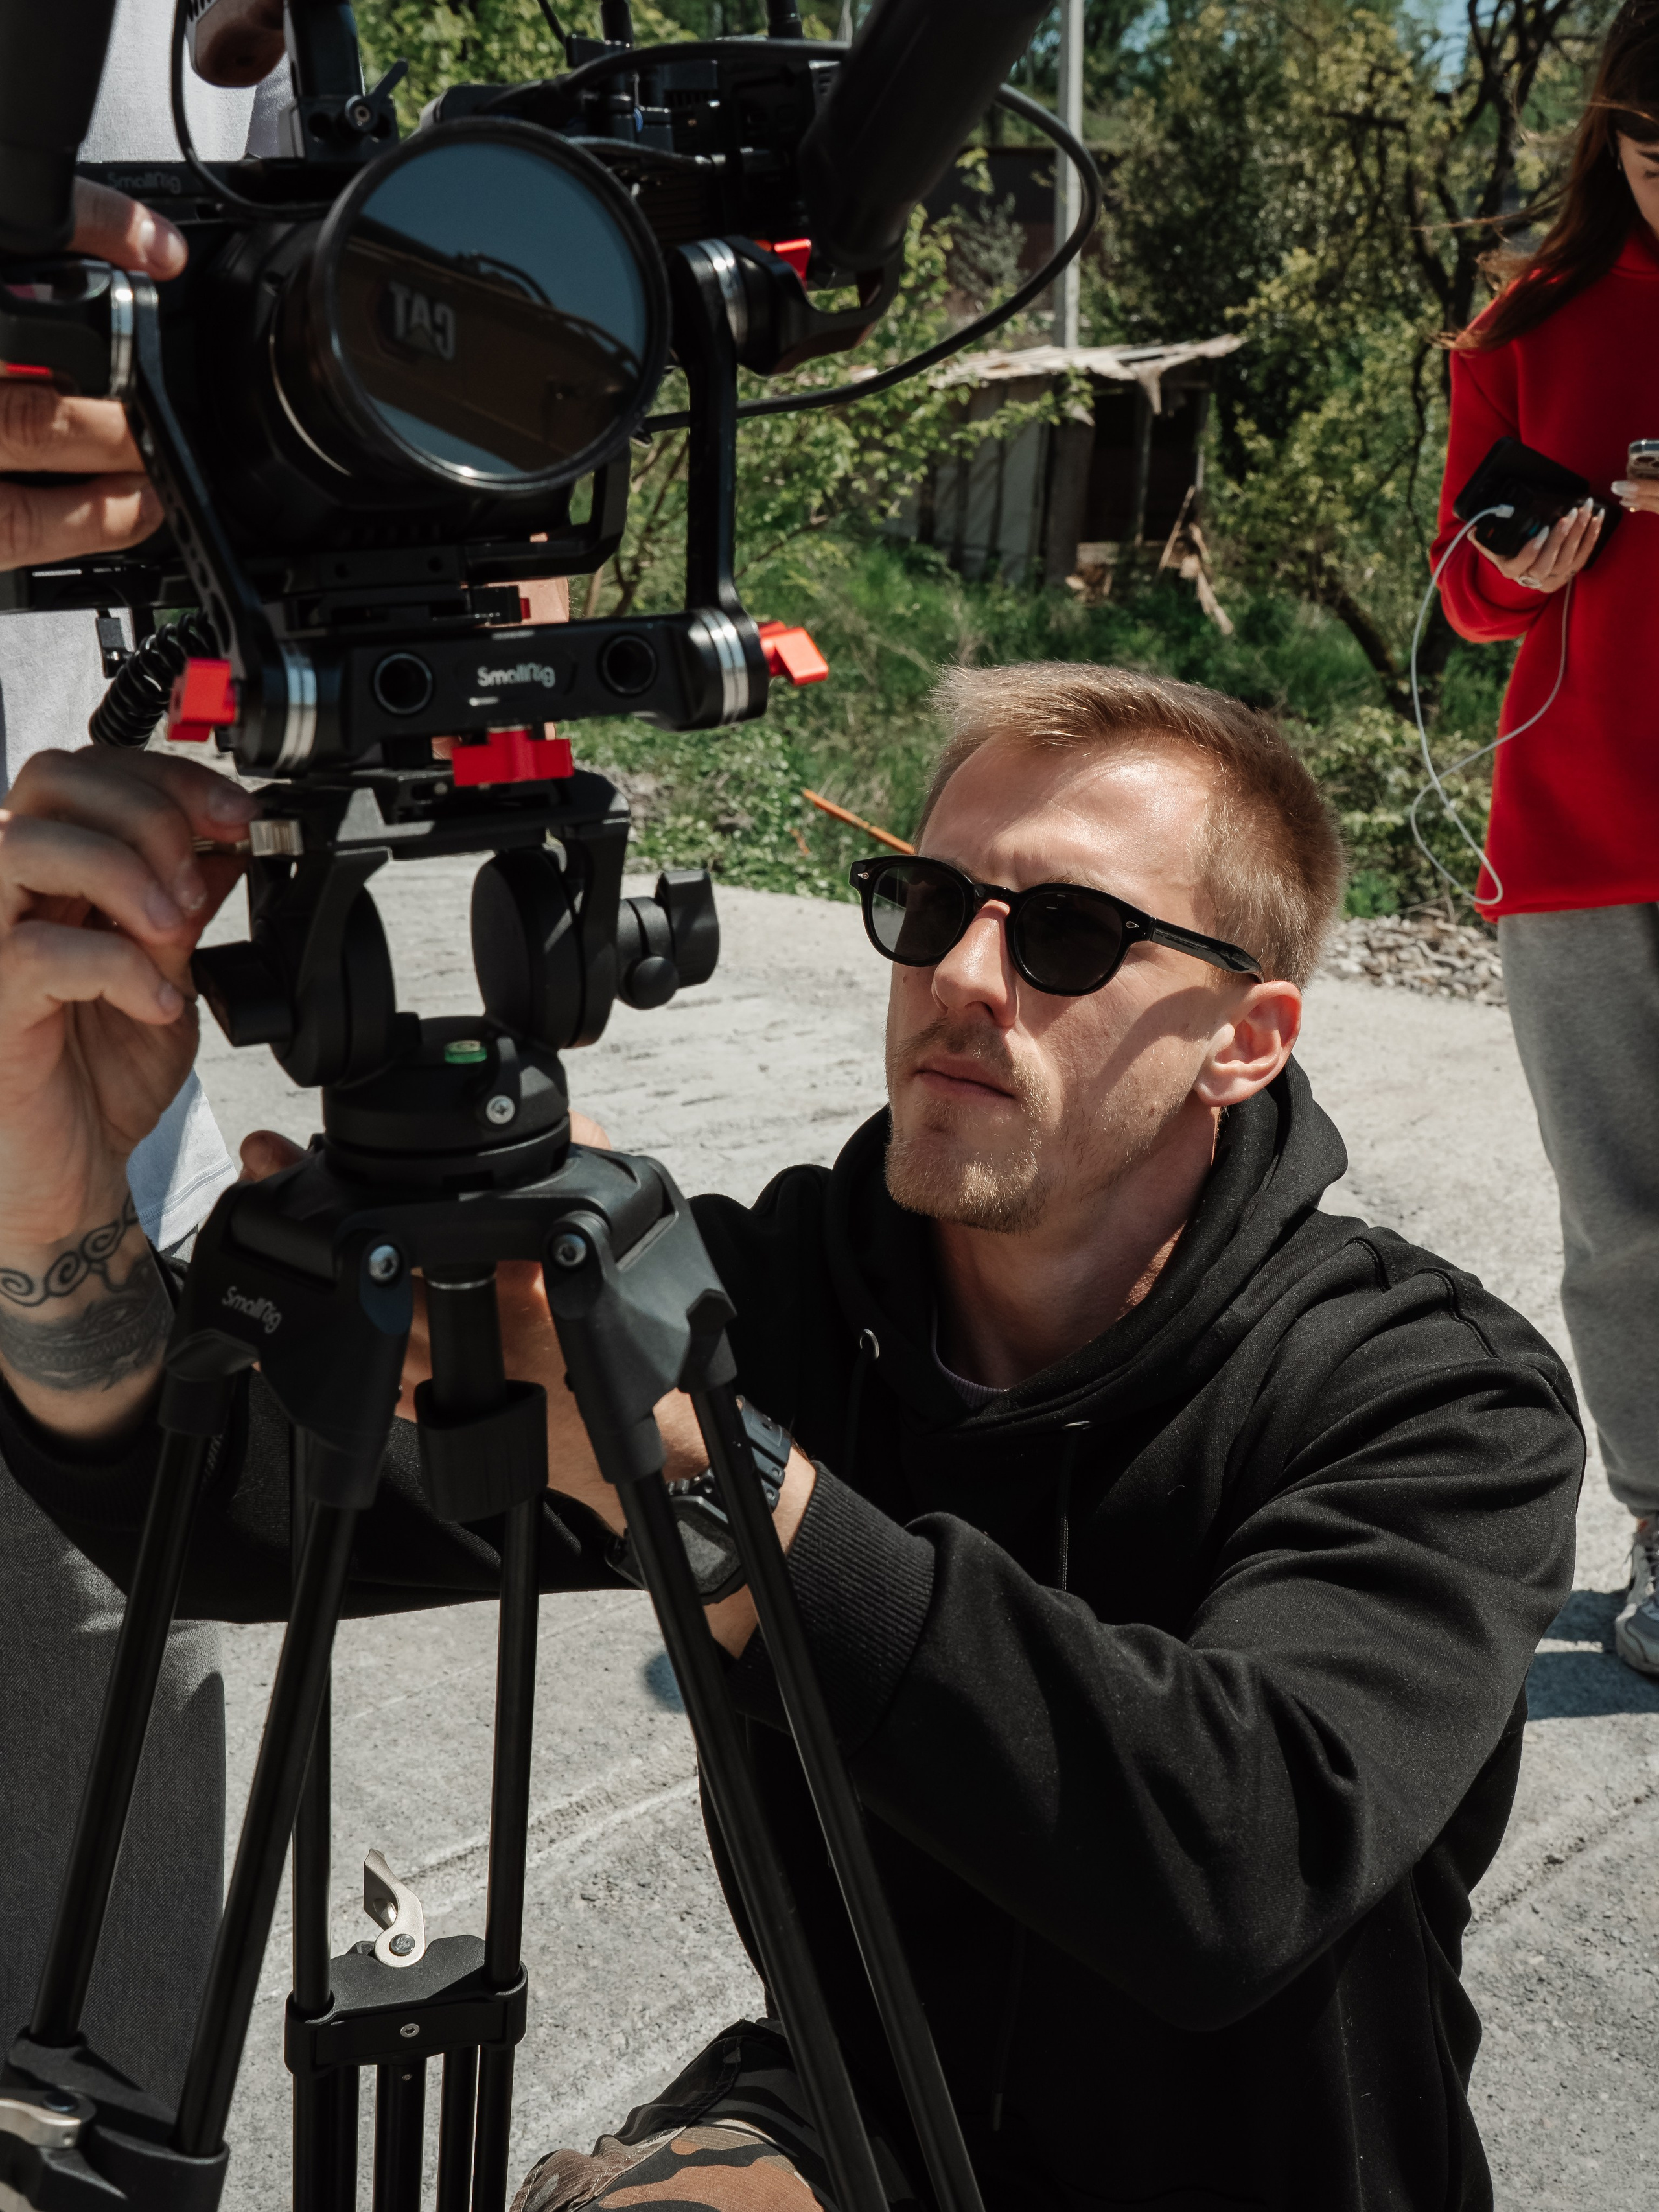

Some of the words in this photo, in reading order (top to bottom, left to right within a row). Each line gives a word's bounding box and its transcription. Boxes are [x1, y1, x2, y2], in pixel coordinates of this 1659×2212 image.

[106, 171, 181, 195] SmallRig
[476, 662, 557, 689] SmallRig
[221, 1285, 283, 1334] SmallRig
